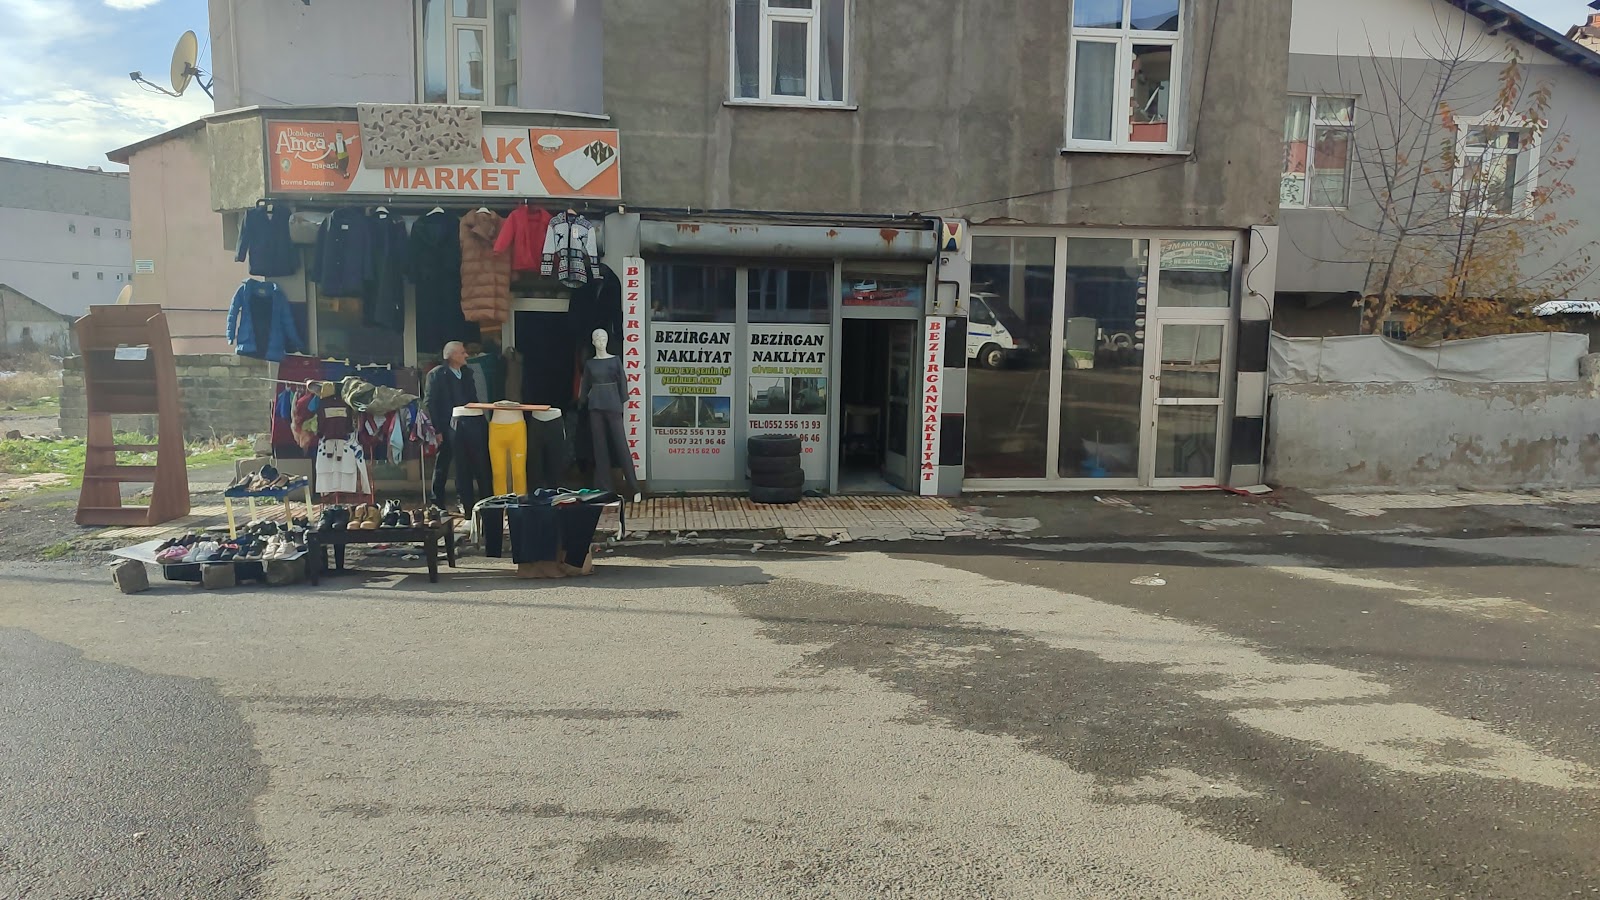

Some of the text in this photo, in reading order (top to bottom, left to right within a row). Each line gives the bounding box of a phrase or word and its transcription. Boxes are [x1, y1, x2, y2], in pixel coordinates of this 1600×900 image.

[275, 131, 326, 154] Amca
[384, 166, 520, 190] MARKET
[654, 328, 730, 344] BEZİRGAN
[750, 332, 824, 346] BEZİRGAN
[656, 348, 732, 363] NAKLİYAT
[752, 349, 826, 362] NAKLİYAT
[680, 366, 695, 374] EVE
[749, 420, 782, 428] TEL:0552
[812, 421, 820, 429] 93
[811, 434, 820, 442] 46
